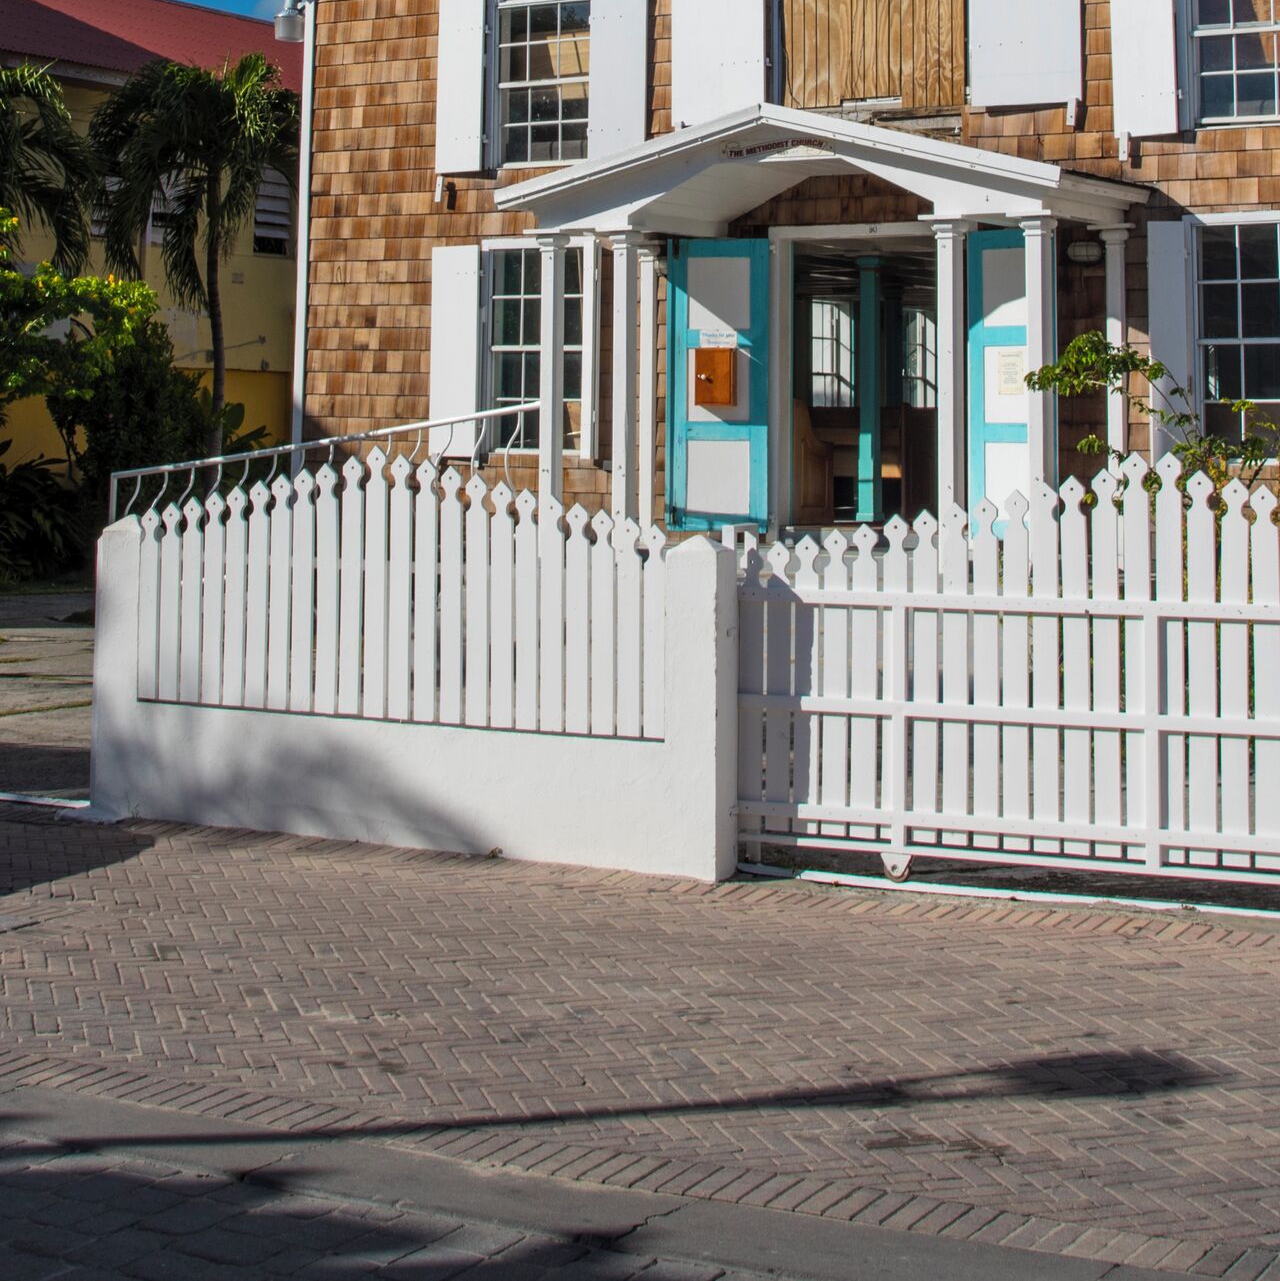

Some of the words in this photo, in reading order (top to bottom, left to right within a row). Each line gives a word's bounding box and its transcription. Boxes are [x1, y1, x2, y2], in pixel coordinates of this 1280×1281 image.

[729, 149, 744, 158] THE
[745, 140, 790, 156] METHODIST
[791, 138, 824, 150] CHURCH
